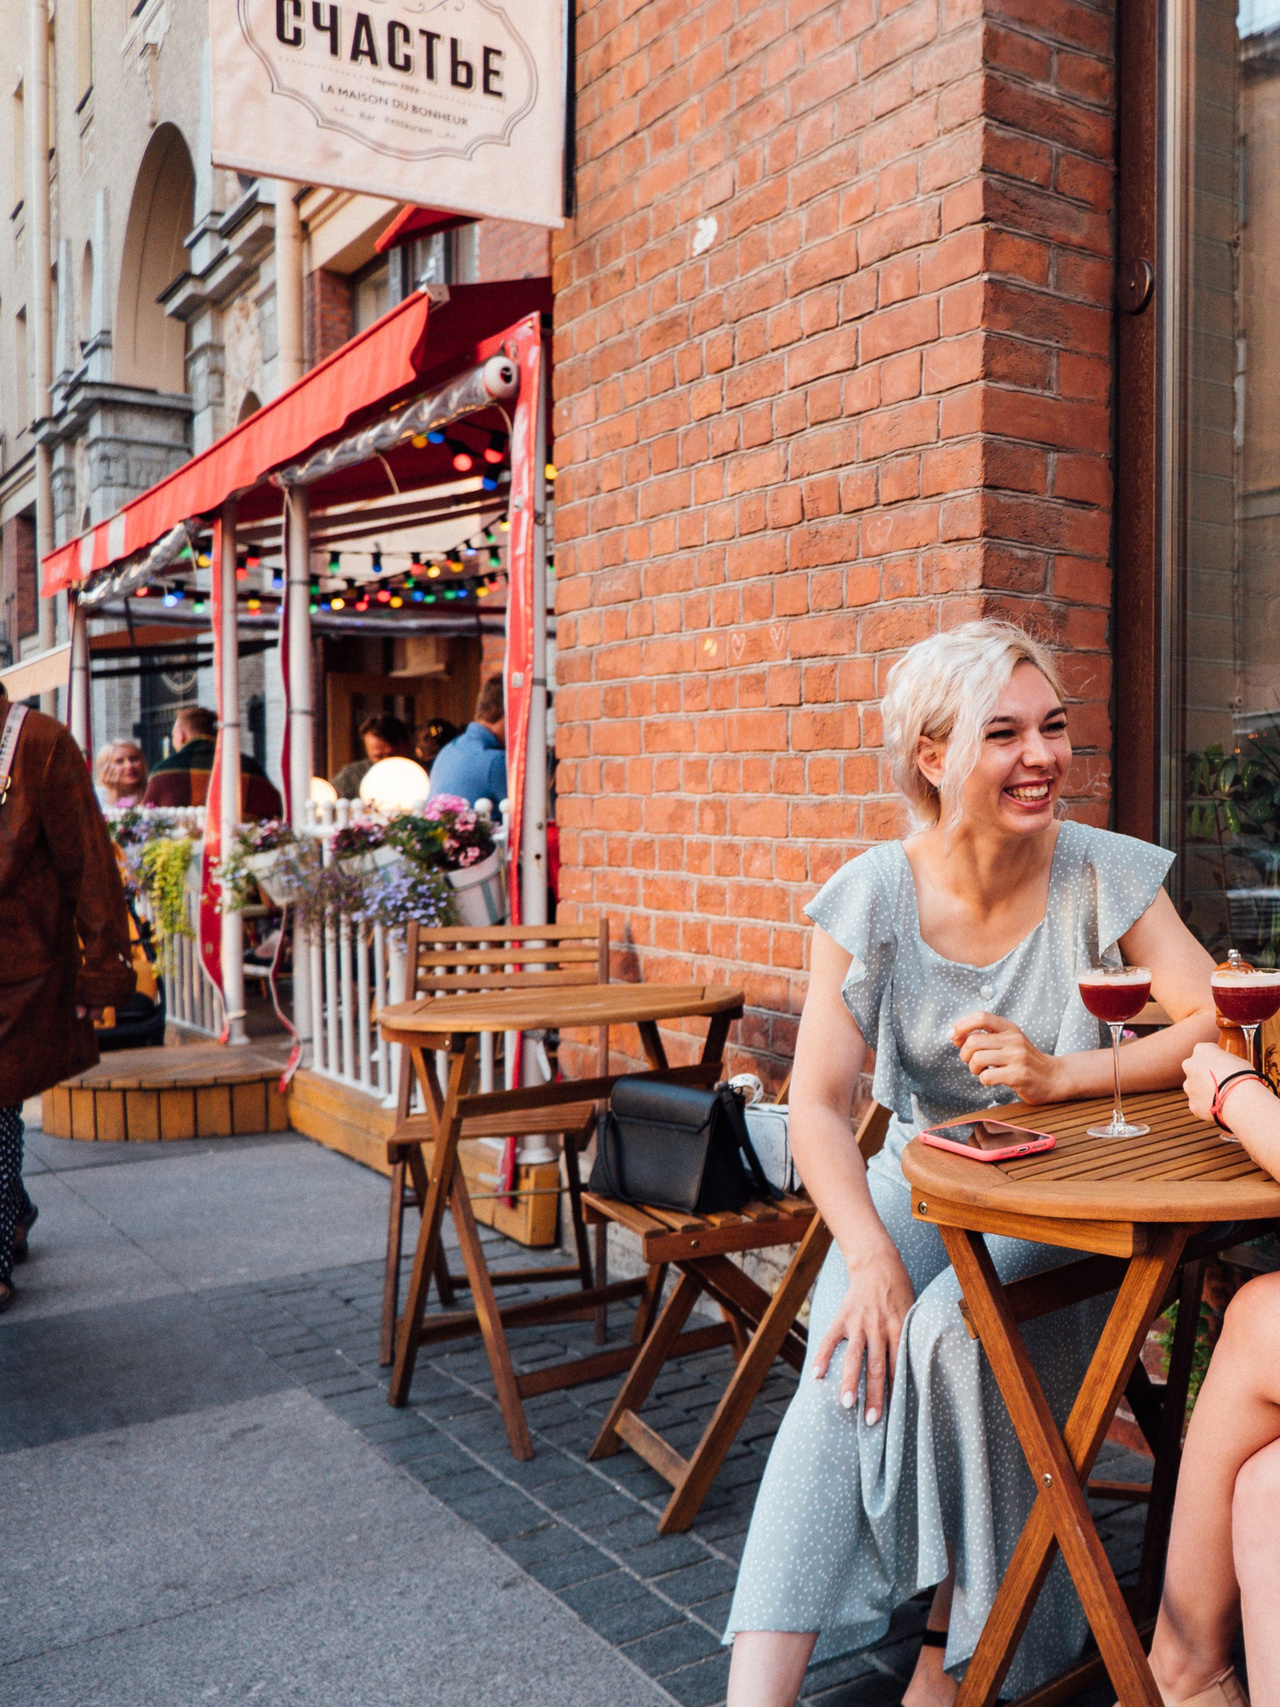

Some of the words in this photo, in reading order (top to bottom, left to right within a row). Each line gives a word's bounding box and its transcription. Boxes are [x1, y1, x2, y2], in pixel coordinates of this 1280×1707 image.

[275, 0, 505, 98] СЧАСТЬЕ
[320, 82, 335, 94] LA
[338, 87, 388, 106] MAISON
[392, 98, 409, 111] DU
[411, 105, 469, 126] BONHEUR
